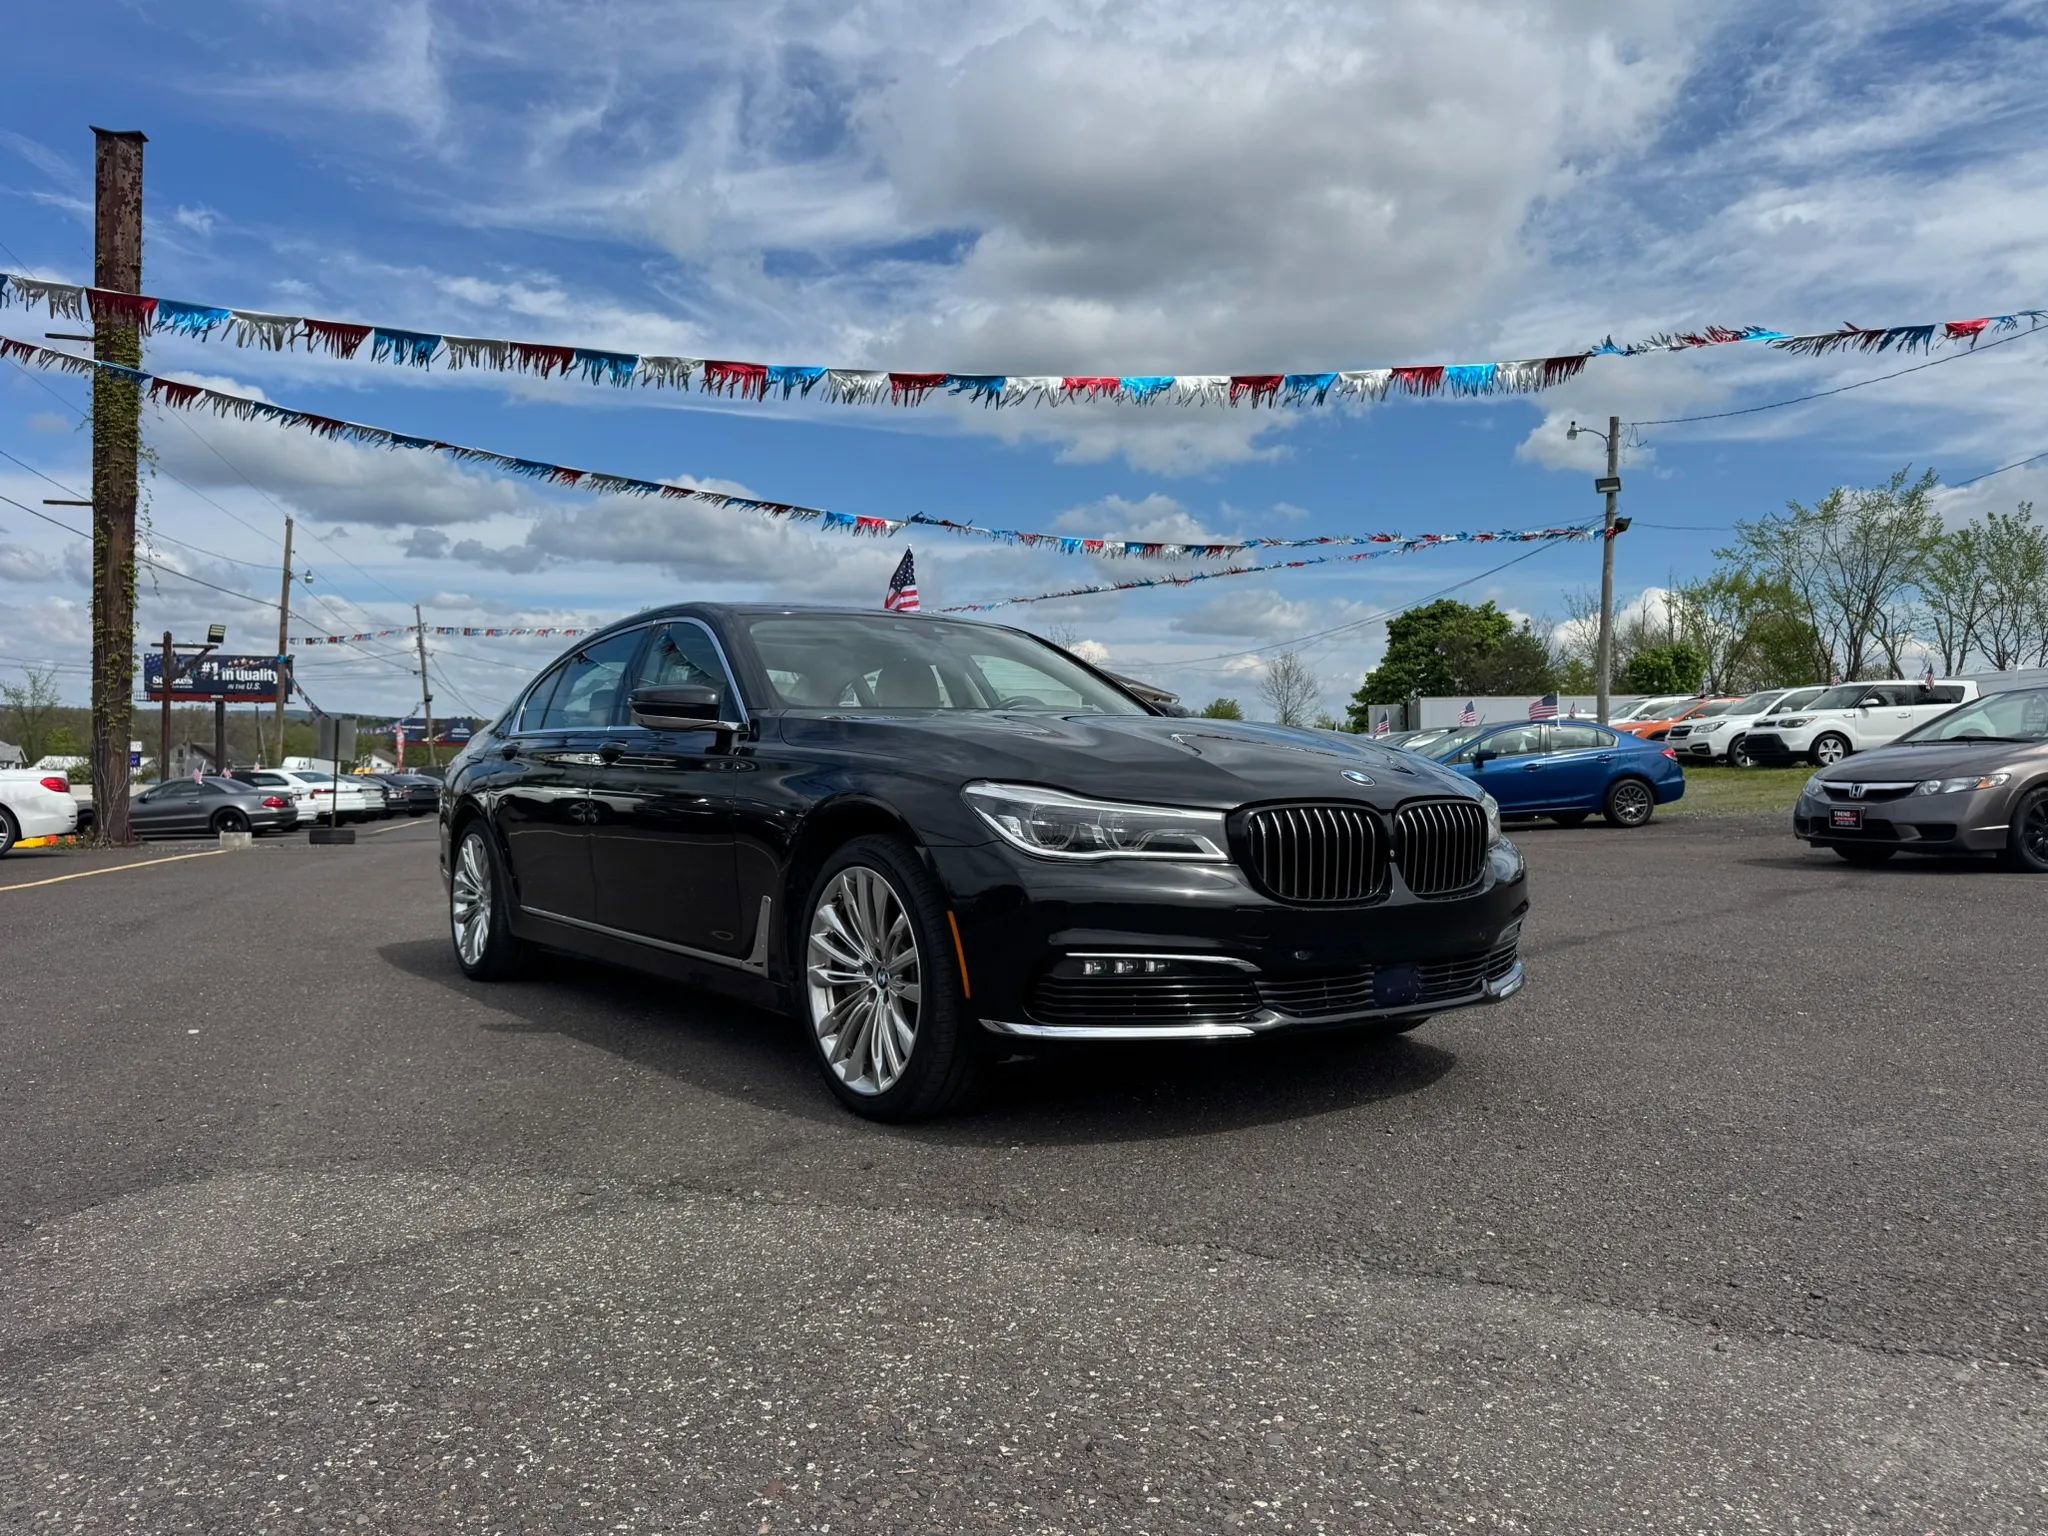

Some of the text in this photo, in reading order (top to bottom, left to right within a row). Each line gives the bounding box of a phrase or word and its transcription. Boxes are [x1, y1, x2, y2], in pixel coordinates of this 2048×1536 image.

[201, 661, 278, 684] #1 in Quality
[246, 682, 261, 690] U.S.
